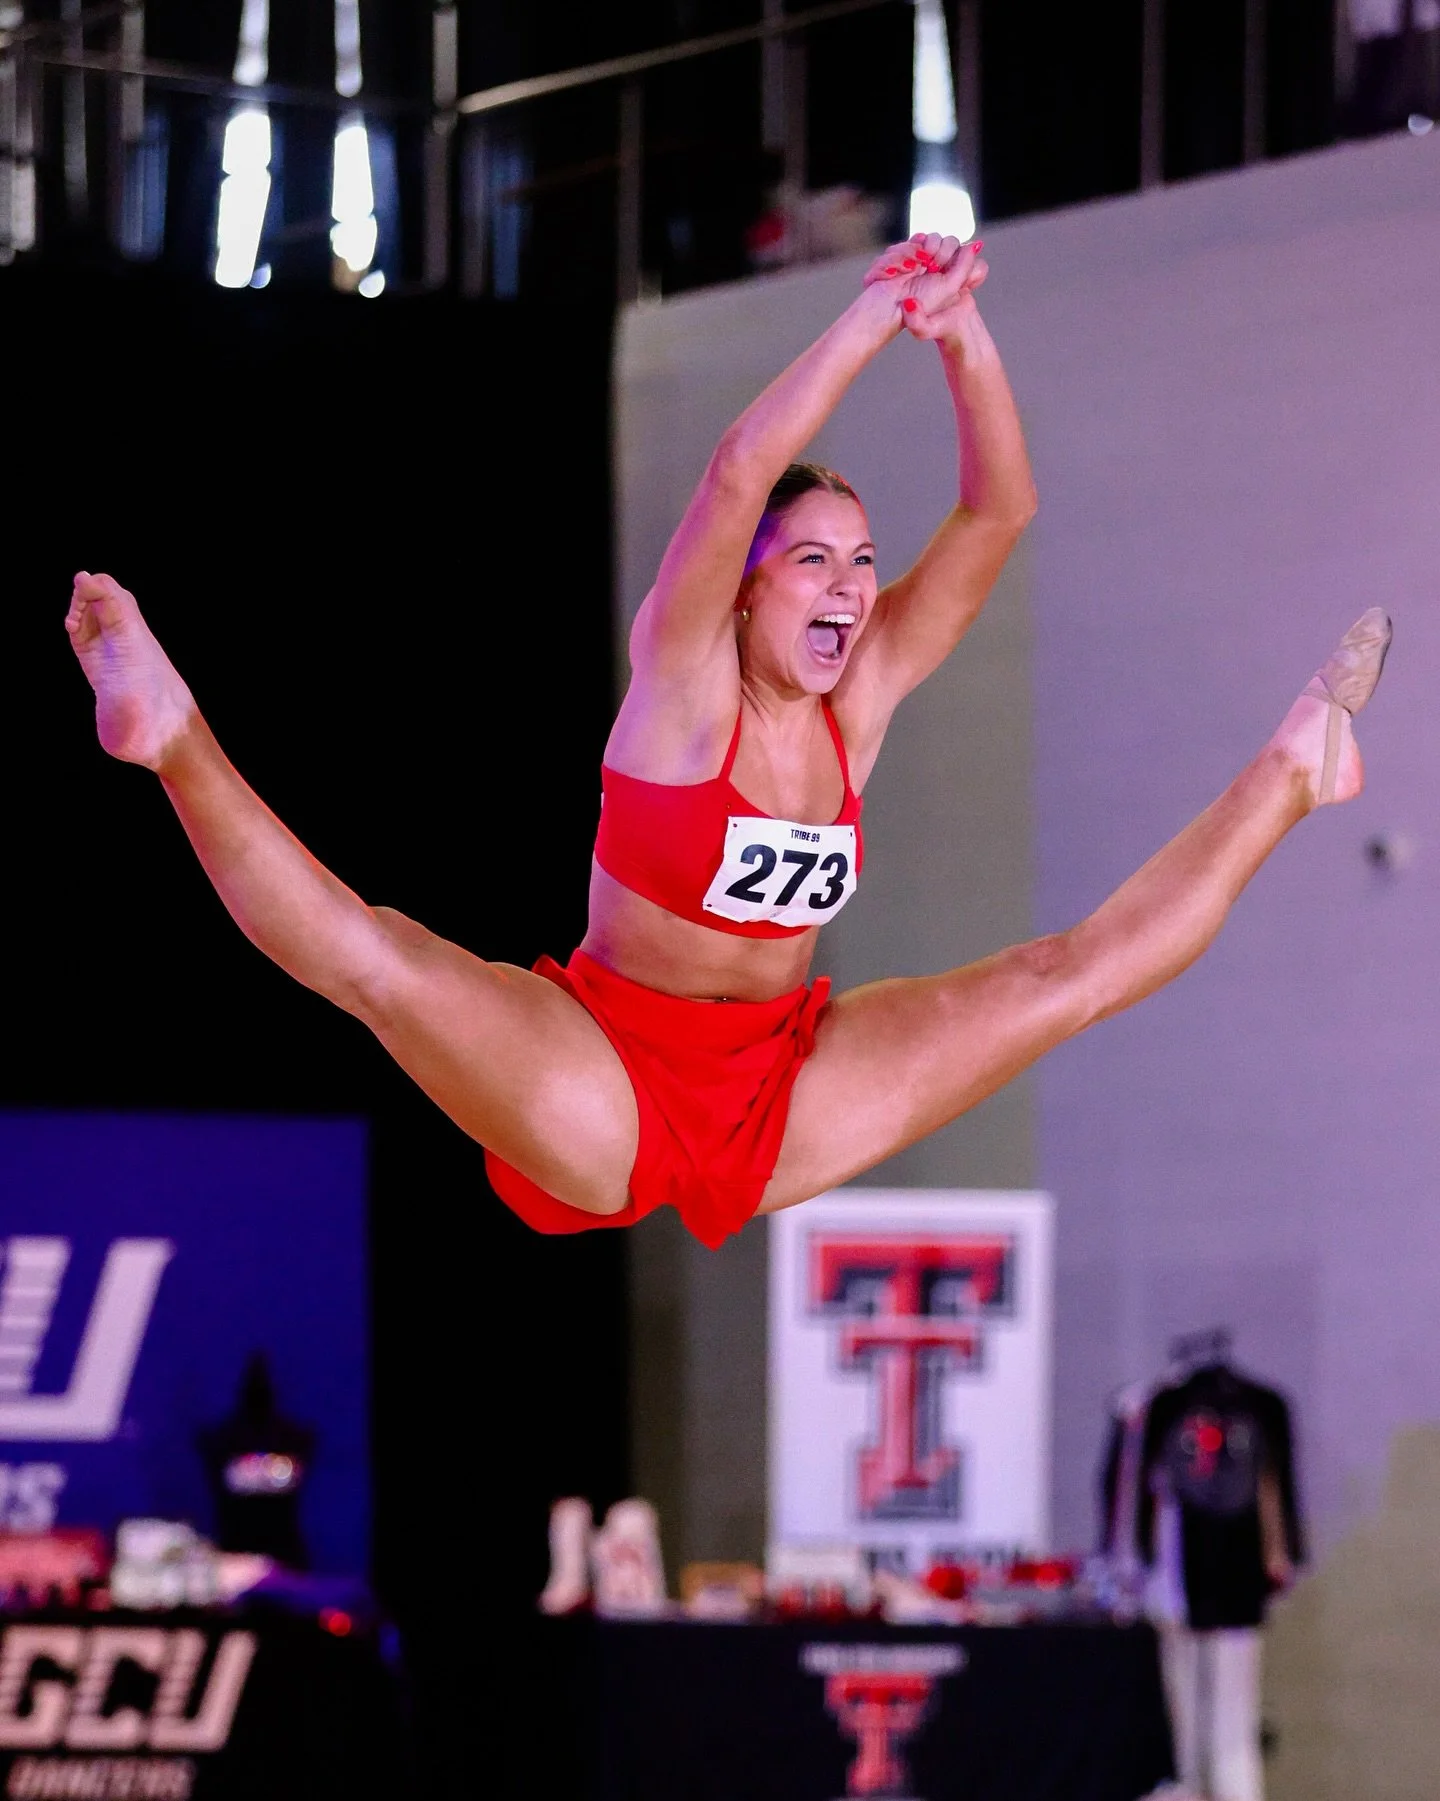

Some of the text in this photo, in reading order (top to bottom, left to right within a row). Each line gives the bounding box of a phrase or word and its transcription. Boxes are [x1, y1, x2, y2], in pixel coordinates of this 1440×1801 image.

[790, 828, 821, 843] TRIBE 99
[724, 843, 848, 910] 273
[0, 1625, 257, 1752] GCU
